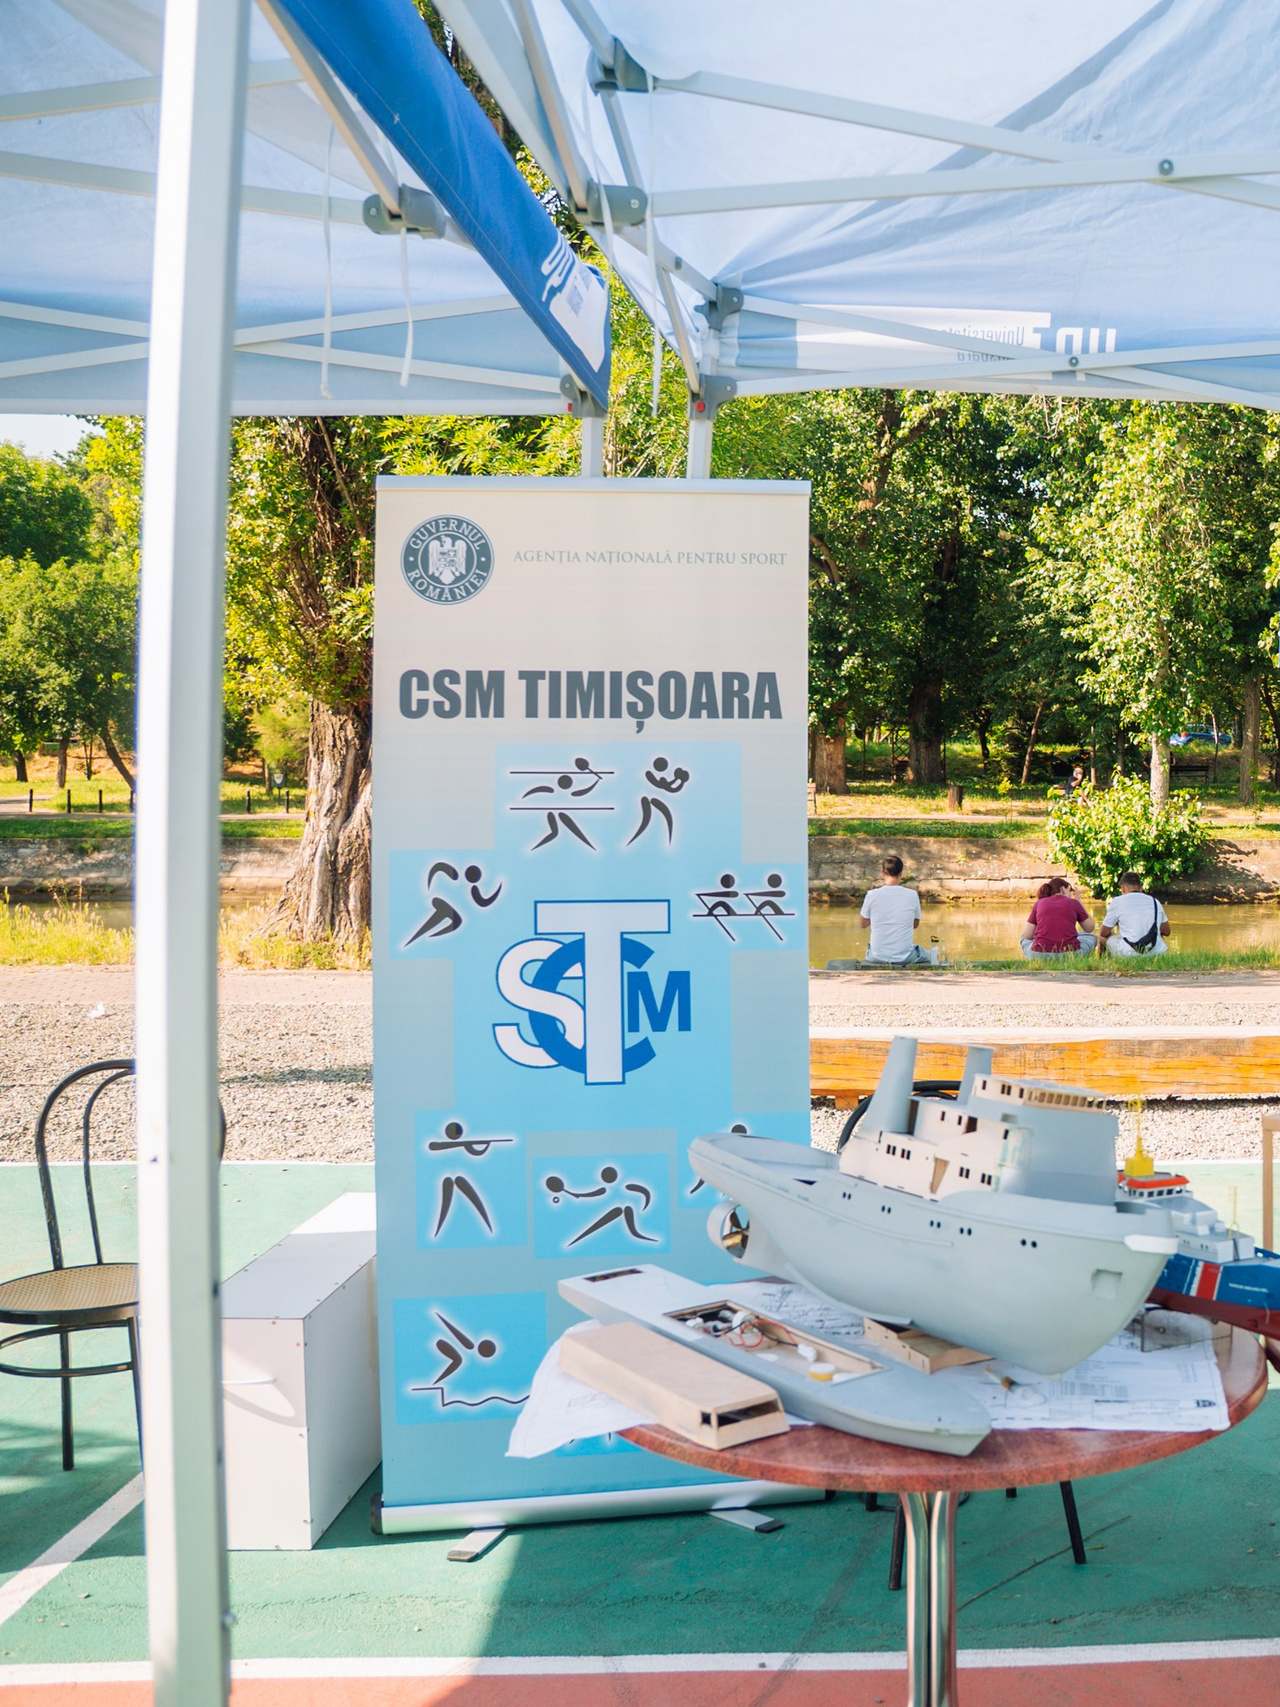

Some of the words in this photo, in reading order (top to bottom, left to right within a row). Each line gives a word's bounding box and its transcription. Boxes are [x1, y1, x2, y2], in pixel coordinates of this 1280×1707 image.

[409, 519, 486, 551] GUVERNUL
[513, 550, 580, 565] AGENȚIA
[677, 552, 736, 565] PENTRU
[740, 552, 788, 566] SPORT
[407, 569, 487, 602] ROMÂNIEI
[399, 669, 505, 720] CSM
[518, 670, 783, 735] TIMIȘOARA
